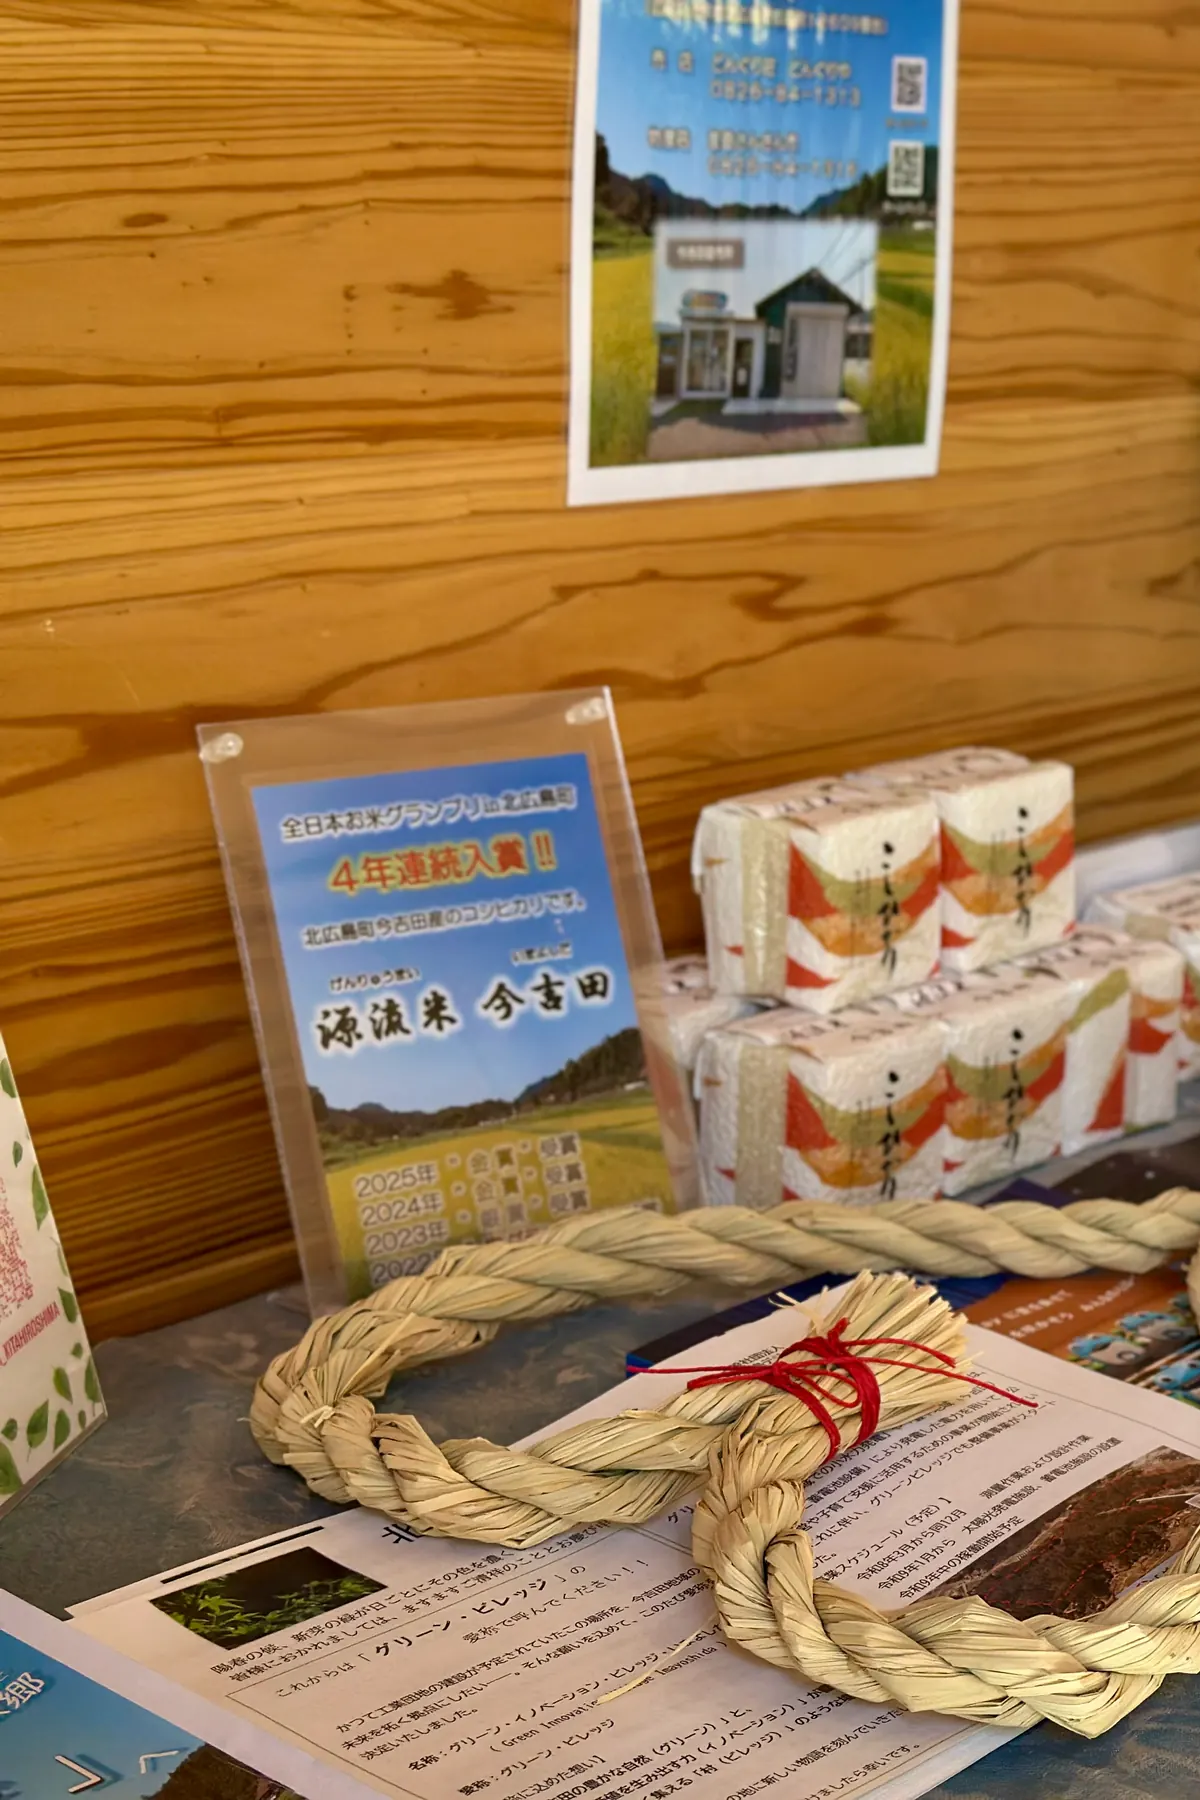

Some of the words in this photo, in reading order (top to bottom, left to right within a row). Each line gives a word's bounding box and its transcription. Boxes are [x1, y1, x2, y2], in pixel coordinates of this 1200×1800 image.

[315, 990, 457, 1050] 源流米
[481, 971, 610, 1021] 今吉田
